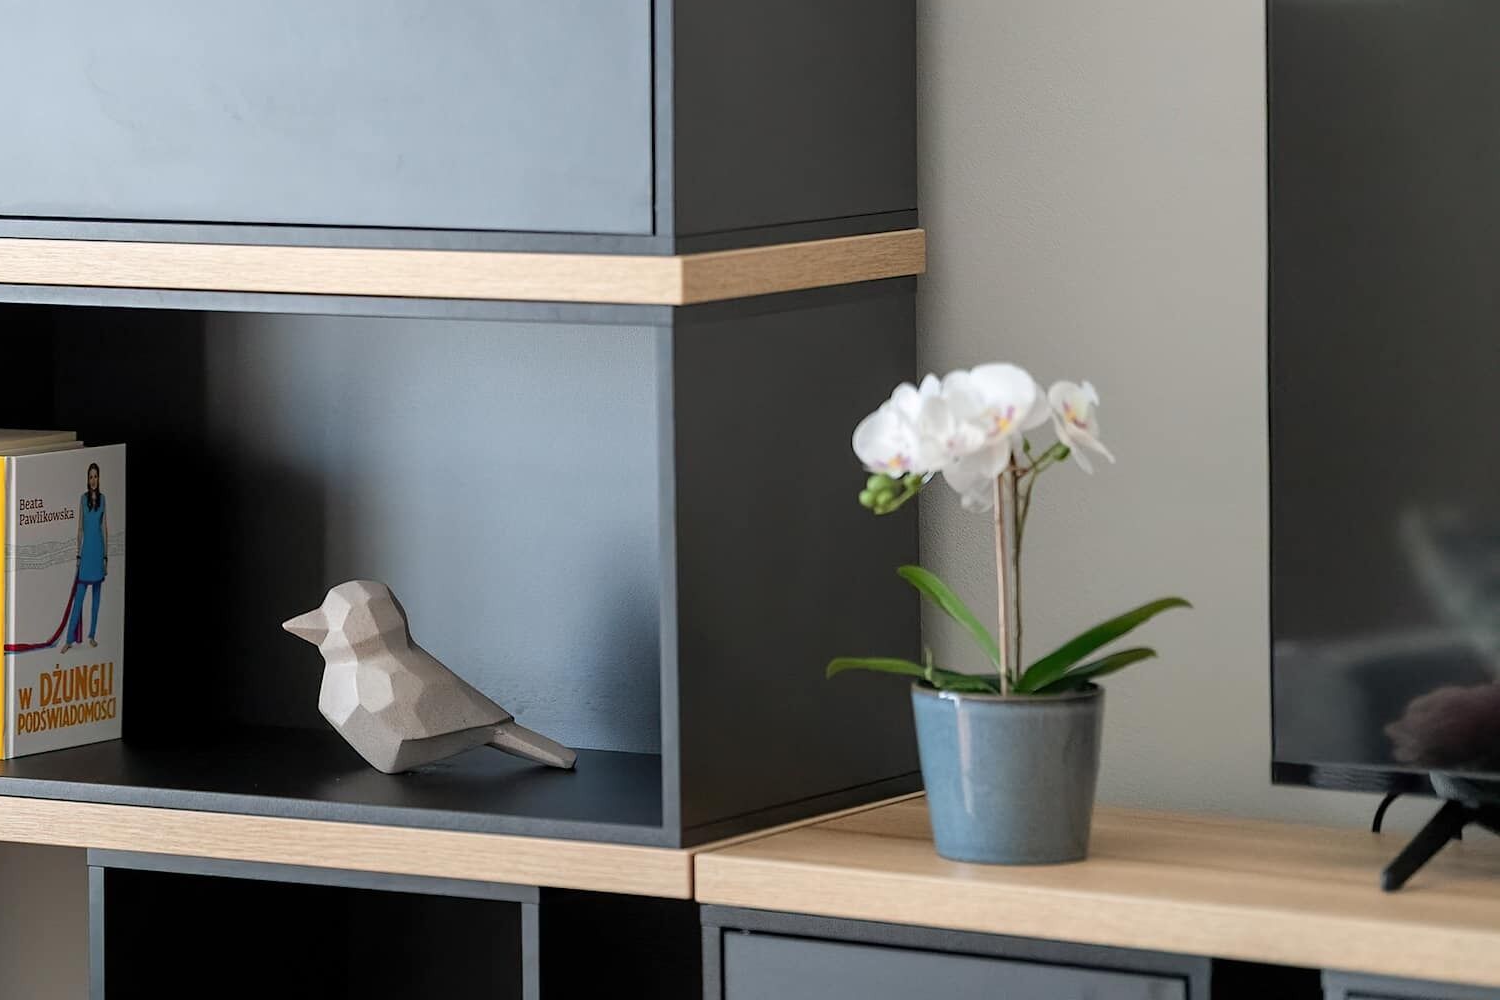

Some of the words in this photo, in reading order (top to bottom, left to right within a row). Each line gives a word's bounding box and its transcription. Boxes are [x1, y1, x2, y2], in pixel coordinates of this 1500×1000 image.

[19, 498, 44, 511] Beata
[19, 507, 76, 526] Pawlikowska
[39, 662, 115, 708] DŻUNGLI
[17, 696, 117, 736] PODŚWIADOMOŚCI
